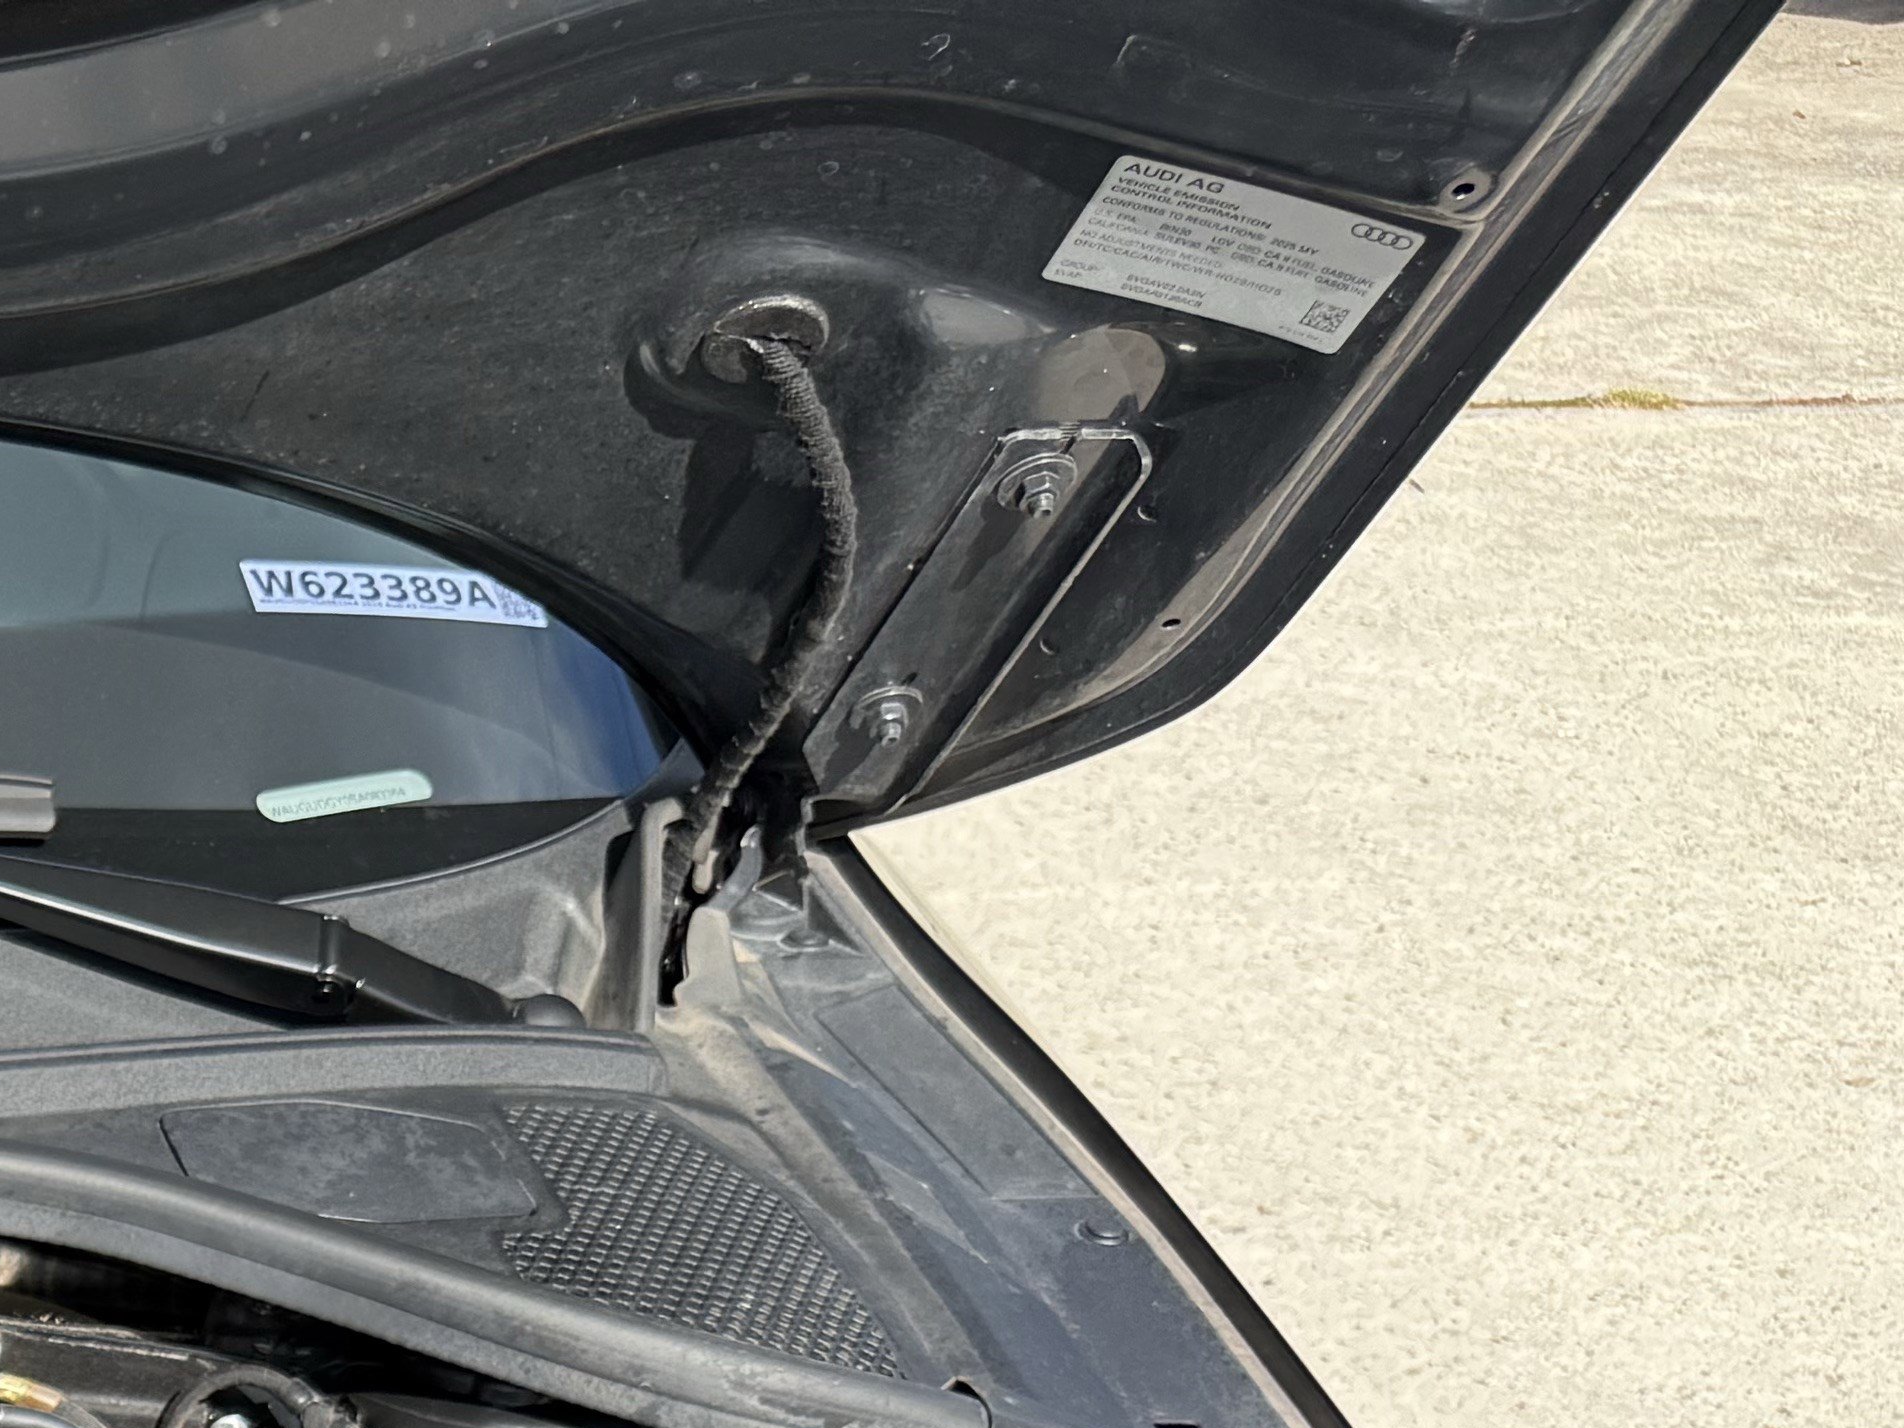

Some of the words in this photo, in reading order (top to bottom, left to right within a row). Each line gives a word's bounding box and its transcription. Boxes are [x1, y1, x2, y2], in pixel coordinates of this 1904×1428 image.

[1117, 177, 1171, 194] VEHICLE
[1174, 190, 1240, 211] EMISSION
[1124, 162, 1184, 183] AUDI
[1187, 178, 1225, 194] AG
[1111, 185, 1171, 204] CONTROL
[1177, 200, 1272, 229] INFORMATION
[1169, 211, 1184, 221] TO
[248, 568, 498, 610] W623389A
